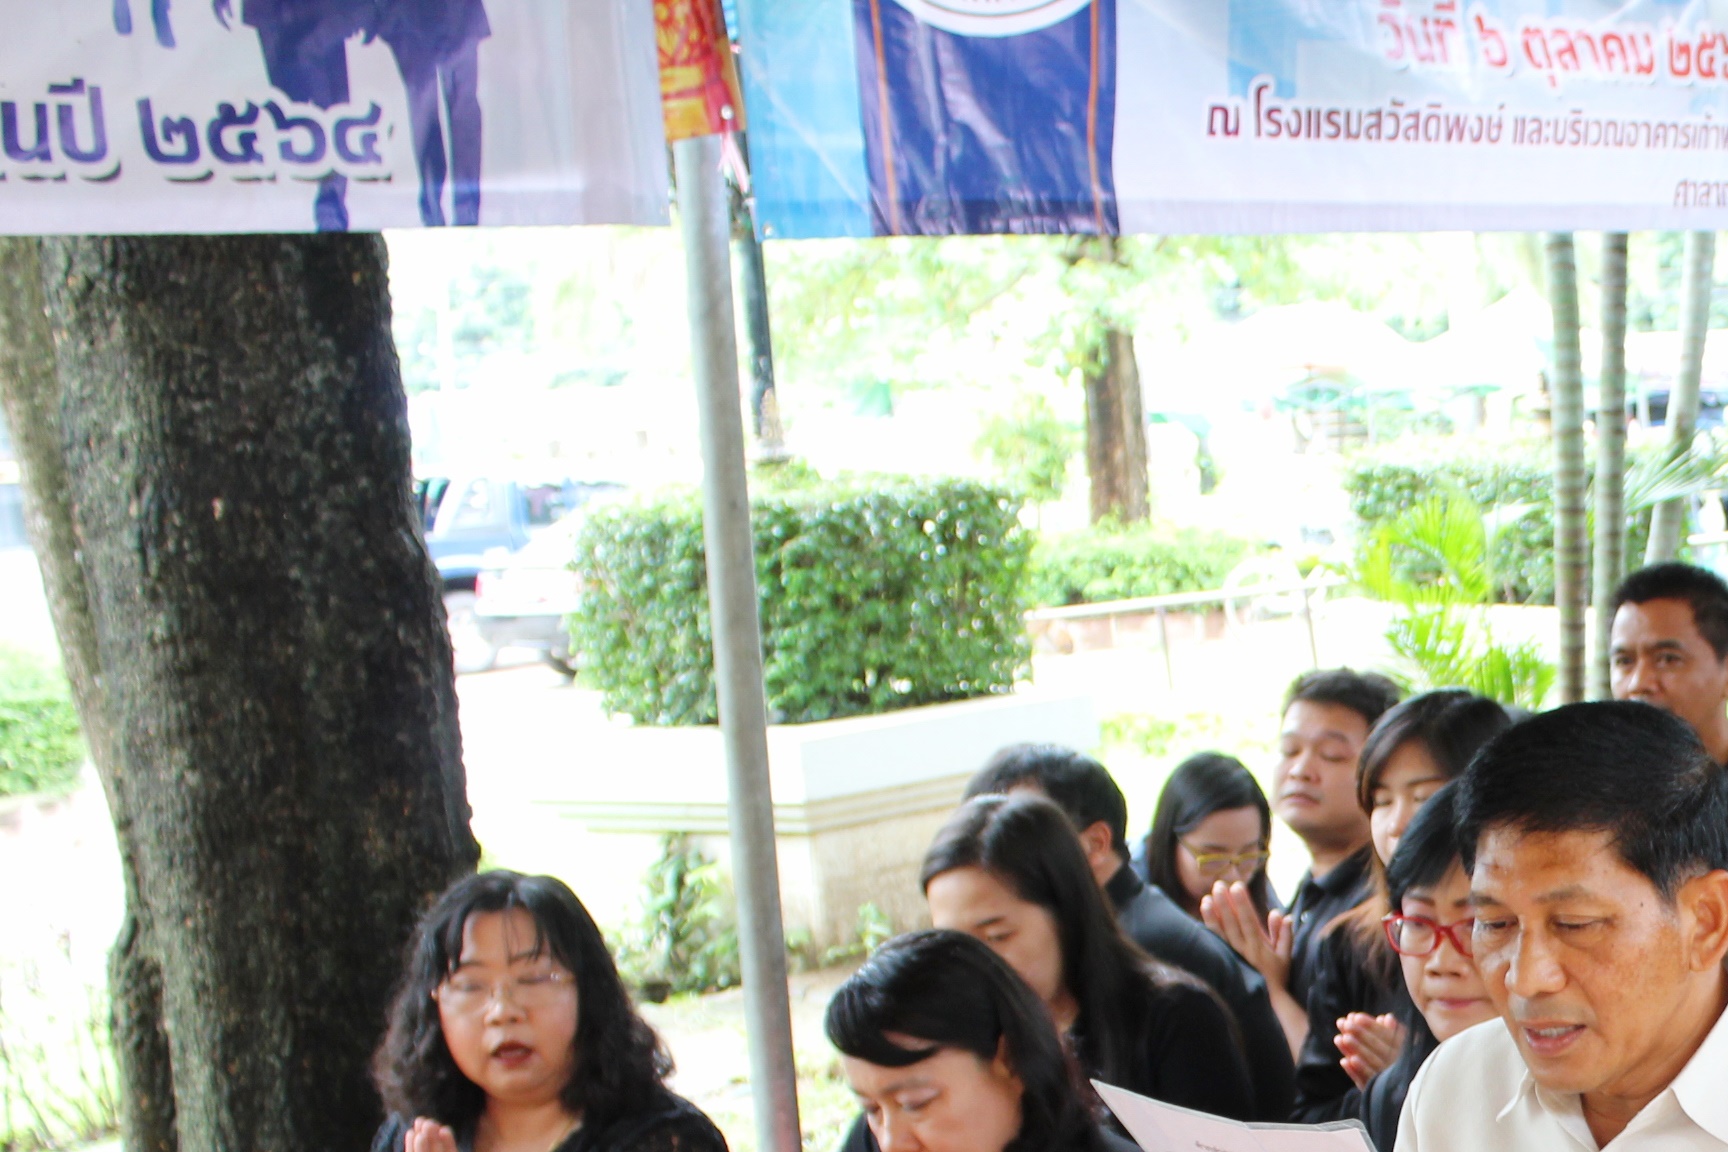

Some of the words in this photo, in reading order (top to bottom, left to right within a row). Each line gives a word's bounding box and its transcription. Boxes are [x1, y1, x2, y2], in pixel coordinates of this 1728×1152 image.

[1474, 15, 1508, 68] ๖
[1521, 26, 1655, 87] ตุลาคม
[1206, 104, 1241, 137] ณ
[1252, 84, 1505, 143] โรงแรมสวัสดิพงษ์
